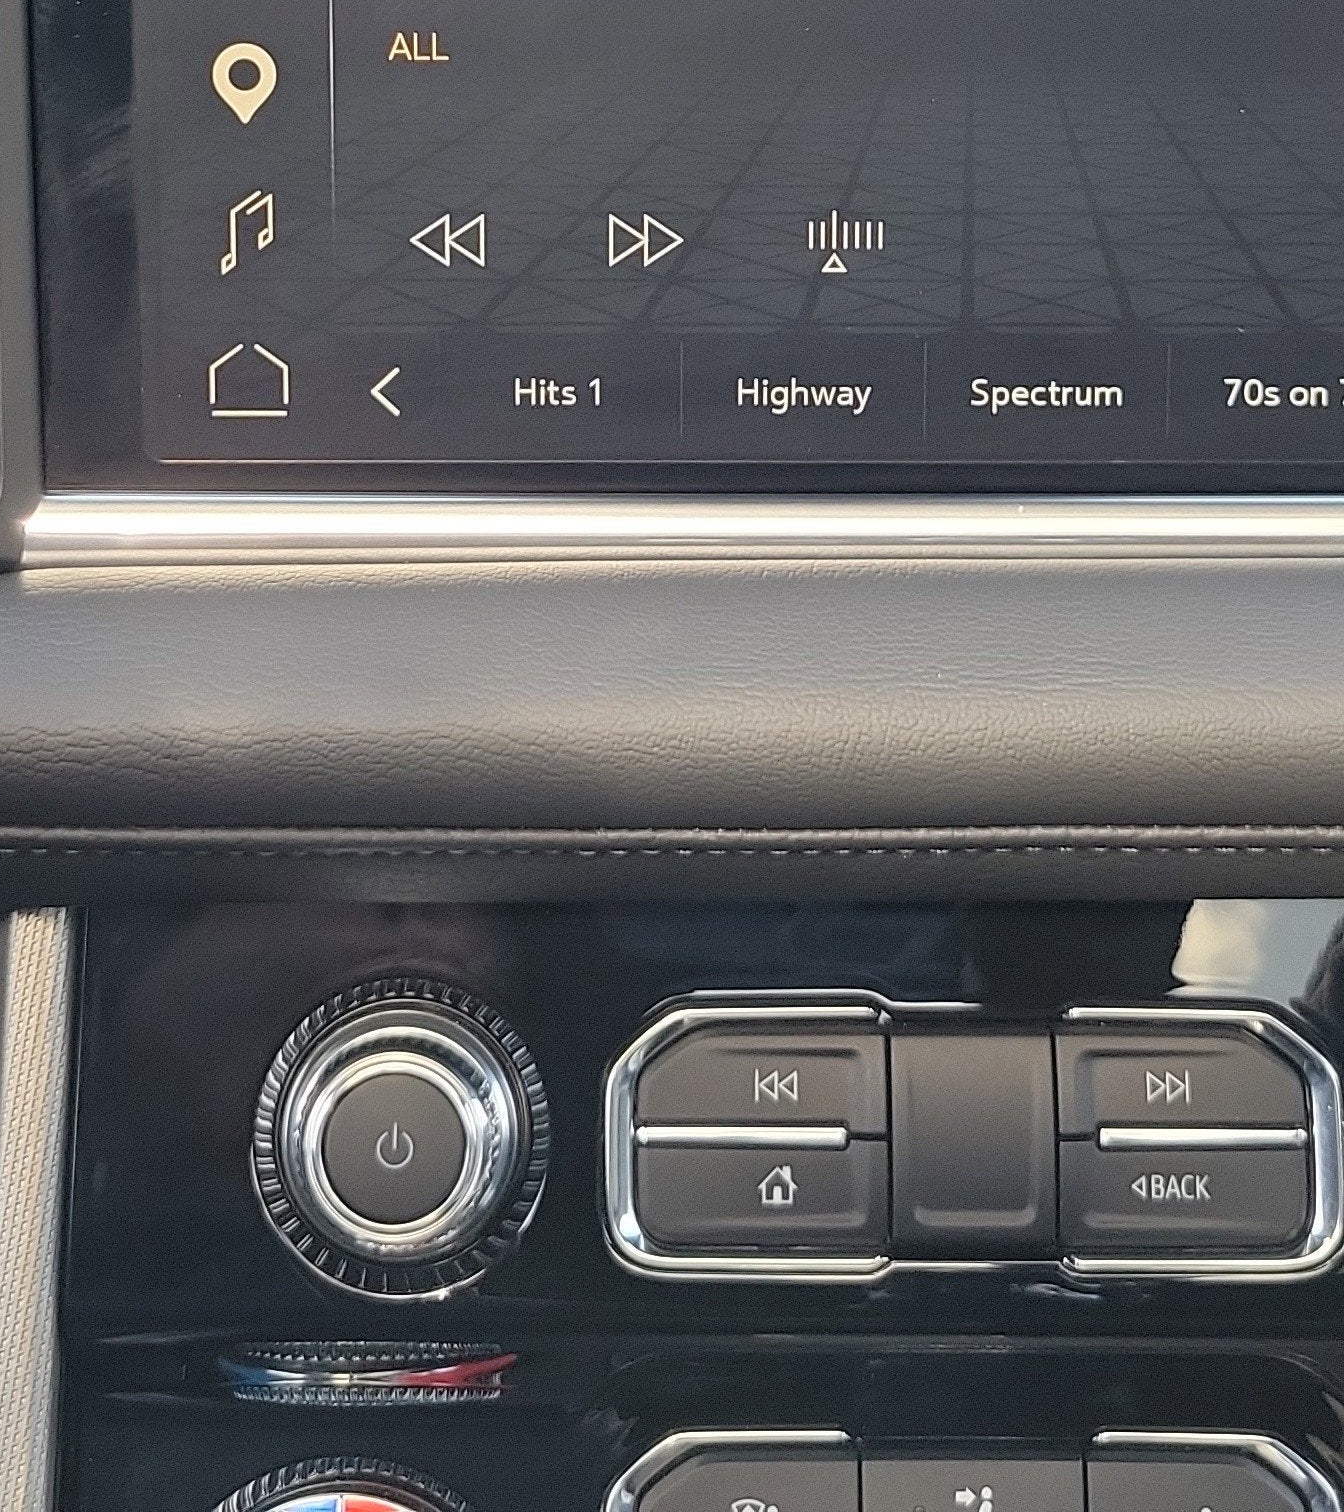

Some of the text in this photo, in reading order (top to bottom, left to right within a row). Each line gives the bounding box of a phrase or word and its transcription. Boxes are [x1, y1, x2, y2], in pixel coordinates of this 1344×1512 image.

[388, 32, 450, 62] ALL
[513, 377, 602, 407] Hits 1
[736, 377, 872, 415] Highway
[970, 378, 1124, 414] Spectrum
[1223, 378, 1280, 408] 70s
[1288, 385, 1327, 408] on
[1150, 1174, 1211, 1201] BACK
